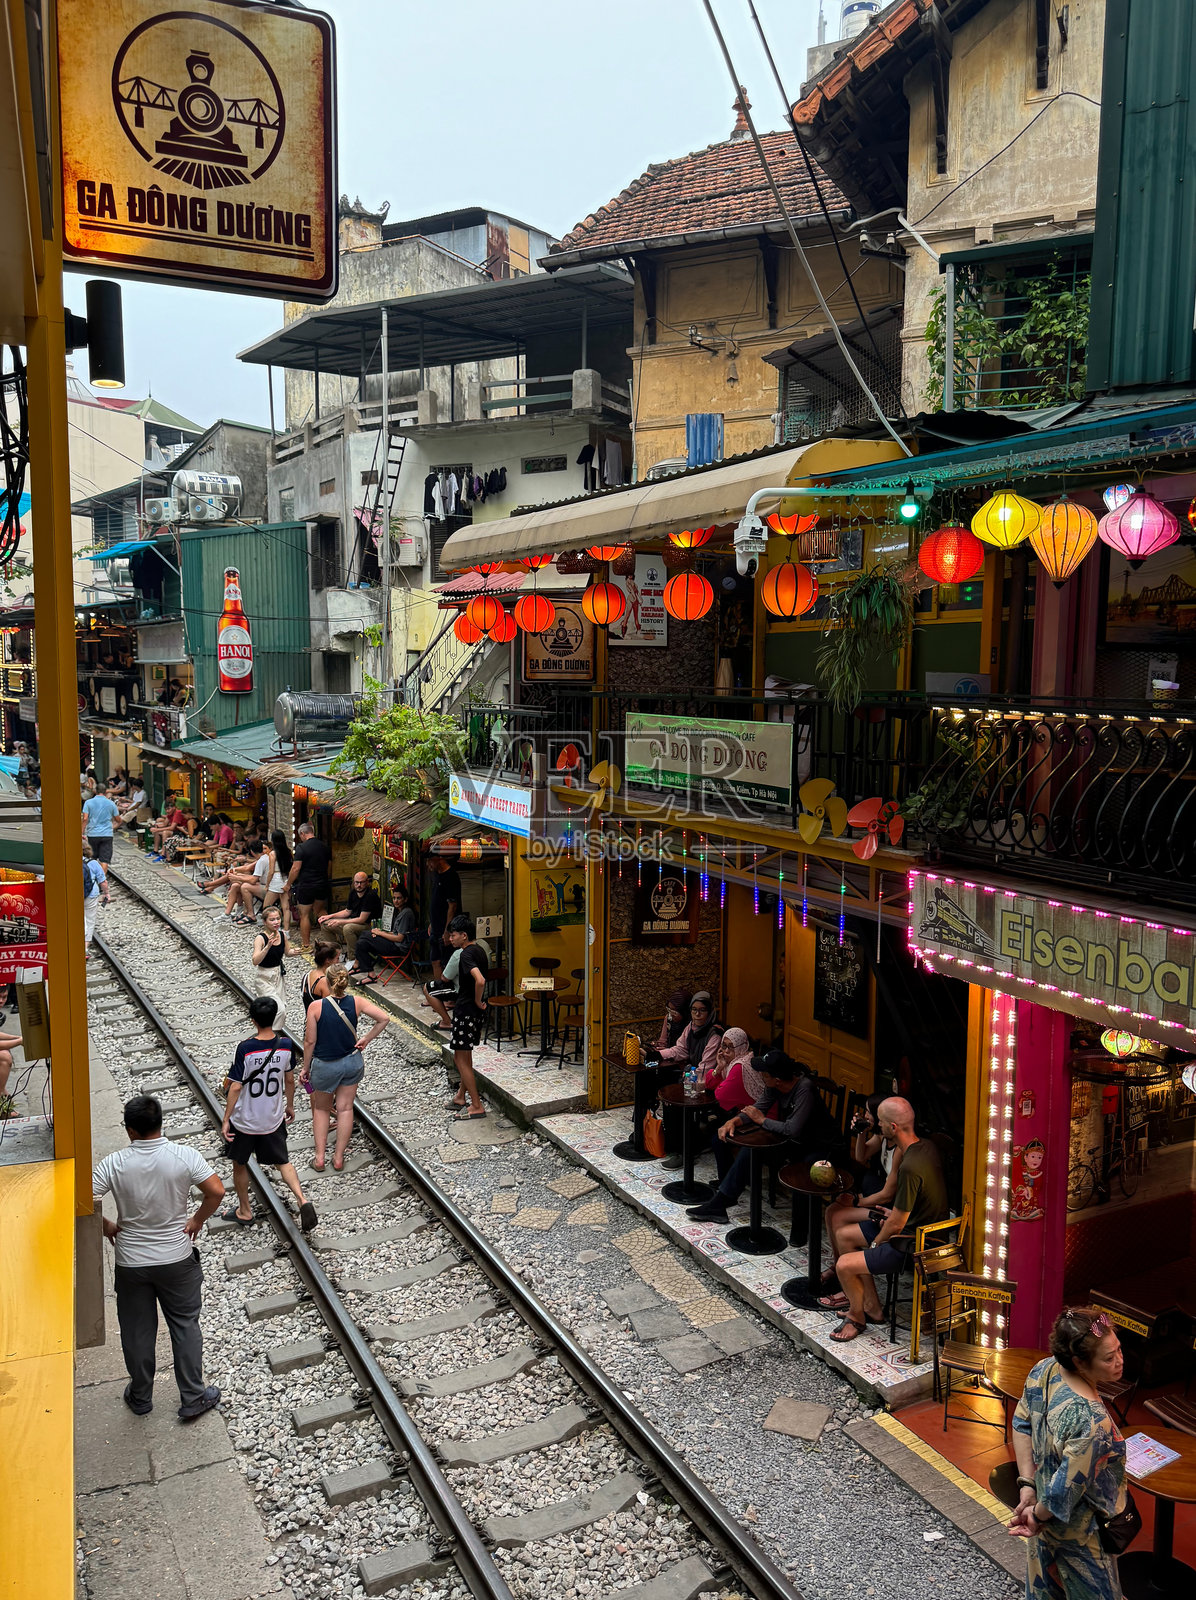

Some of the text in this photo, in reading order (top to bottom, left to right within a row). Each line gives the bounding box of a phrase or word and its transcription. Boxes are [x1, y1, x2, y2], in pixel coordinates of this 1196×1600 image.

[76, 179, 312, 249] GA ĐÔNG DƯƠNG
[220, 645, 251, 658] HANOI
[490, 796, 508, 813] STREET
[508, 802, 529, 818] TRAVEL
[1000, 909, 1196, 1009] Eisenba
[254, 1057, 263, 1066] FC
[249, 1067, 281, 1098] 66
[952, 1285, 1010, 1302] Eisenbahn Kaffee
[1127, 1320, 1147, 1335] Kaffee
